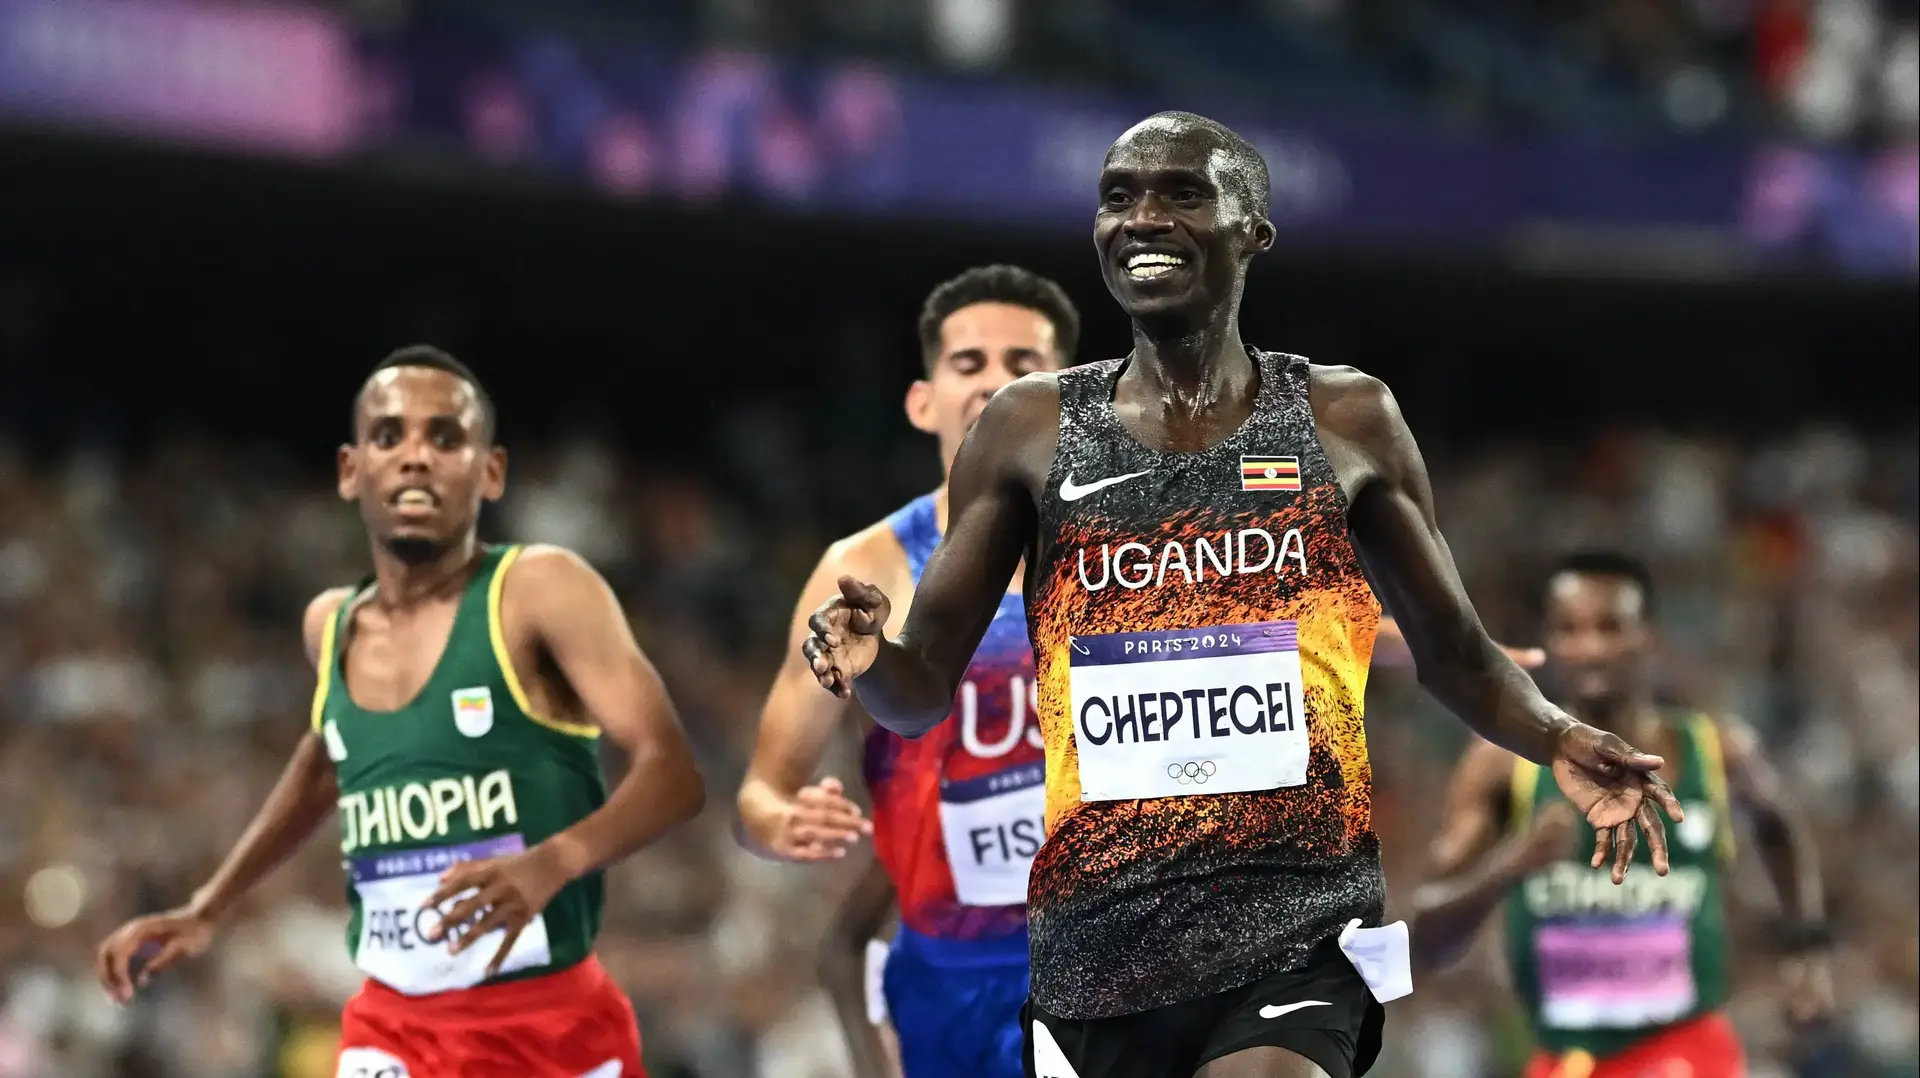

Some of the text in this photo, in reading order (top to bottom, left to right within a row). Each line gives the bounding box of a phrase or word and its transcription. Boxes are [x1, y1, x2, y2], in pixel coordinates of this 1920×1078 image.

[1078, 528, 1307, 591] UGANDA
[1124, 638, 1182, 655] PARIS
[1080, 682, 1295, 746] CHEPTEGEI
[970, 814, 1045, 866] FIS
